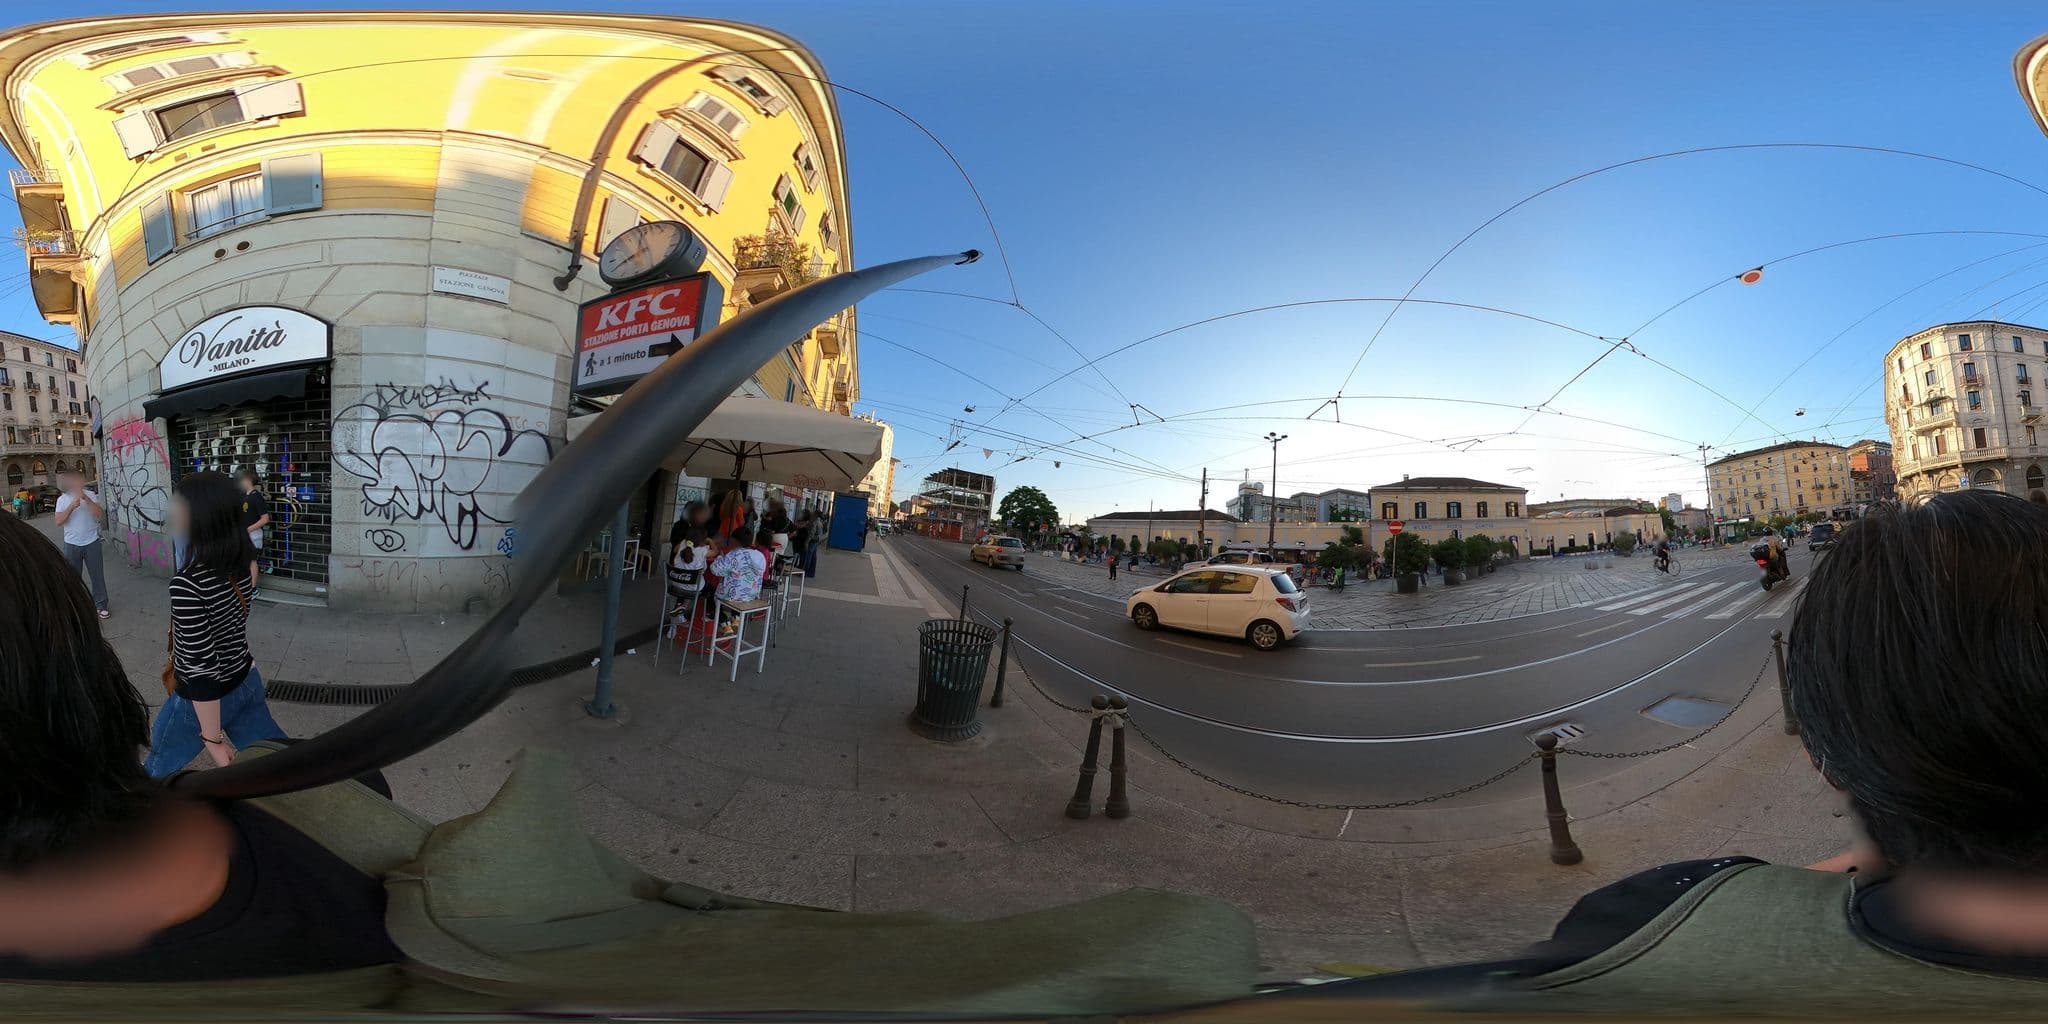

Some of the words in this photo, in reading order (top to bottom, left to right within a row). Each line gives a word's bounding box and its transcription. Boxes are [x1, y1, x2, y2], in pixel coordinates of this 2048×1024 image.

[439, 279, 474, 289] STAZIONE
[477, 285, 505, 295] GENOVA
[595, 288, 681, 331] KFC
[179, 316, 287, 368] Vanità
[584, 328, 619, 348] STAZIONE
[620, 322, 649, 338] PORTA
[651, 315, 690, 331] GENOVA
[599, 359, 605, 367] a
[614, 350, 647, 363] minuto
